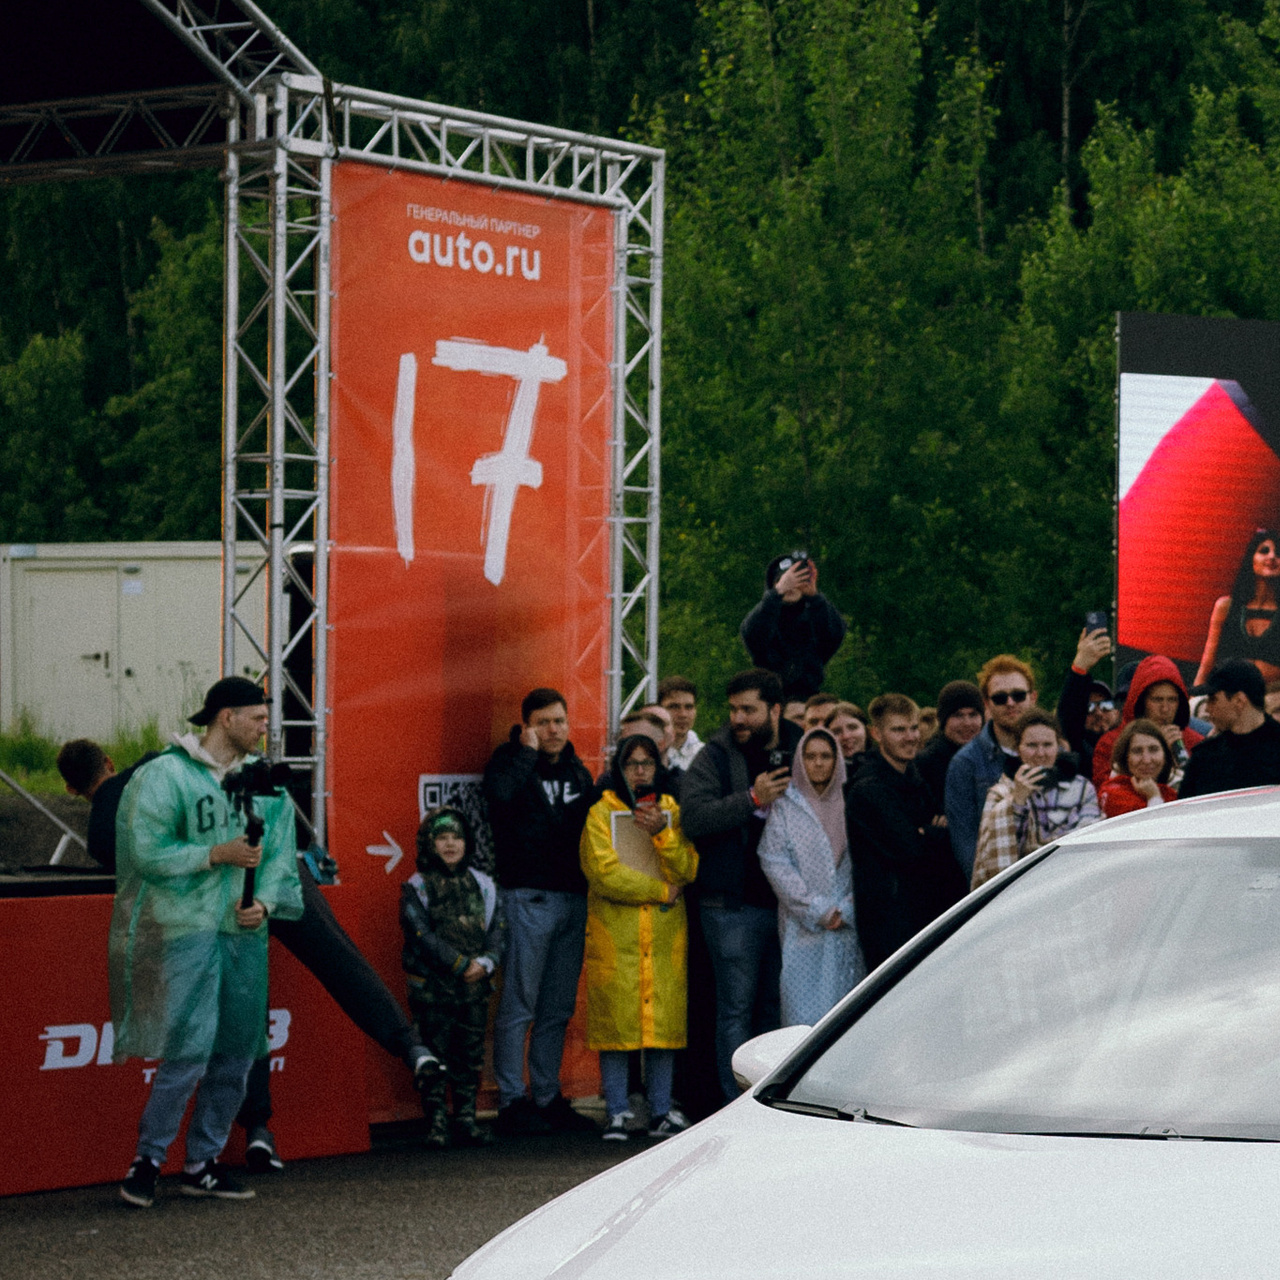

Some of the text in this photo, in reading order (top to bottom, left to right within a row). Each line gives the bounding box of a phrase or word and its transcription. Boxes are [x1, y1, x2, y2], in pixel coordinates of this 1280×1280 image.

[406, 203, 541, 239] ГЕНЕРАЛЬНЫЙ ПАРТНЕР
[408, 230, 541, 281] auto.ru
[390, 334, 568, 587] 17
